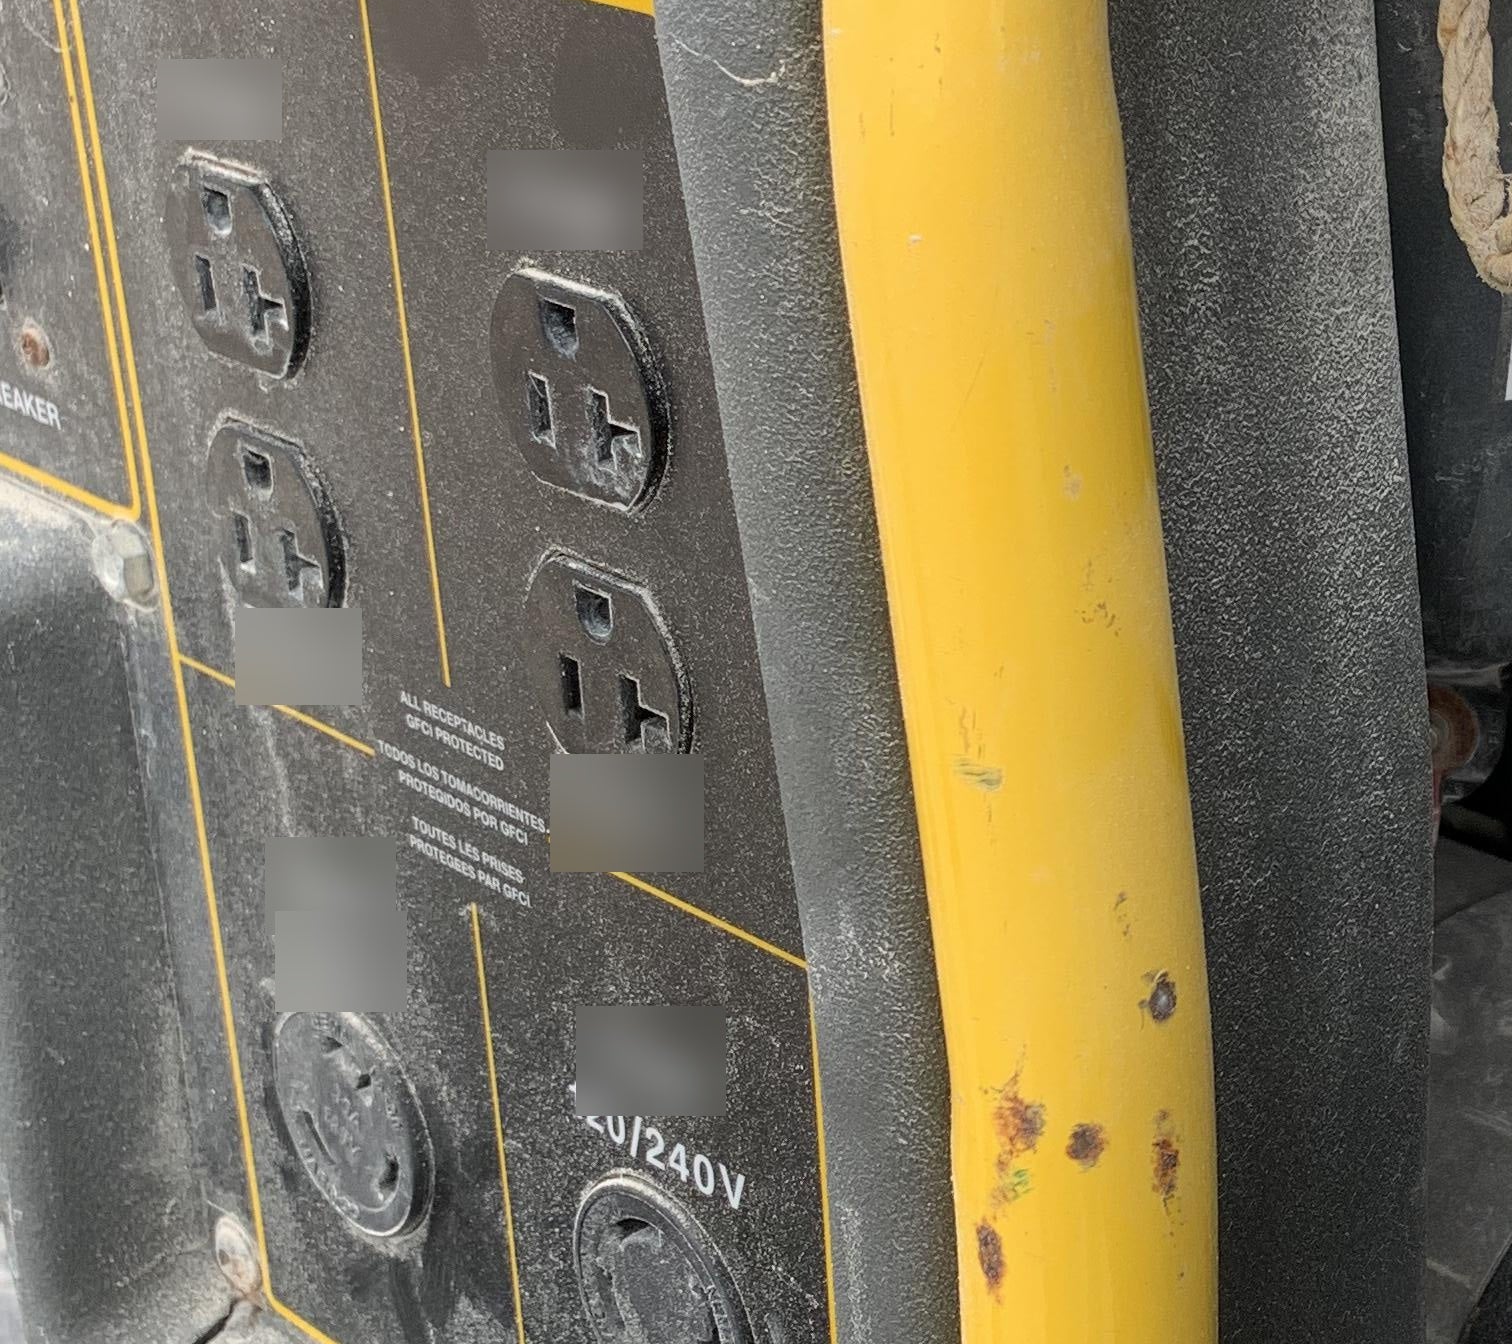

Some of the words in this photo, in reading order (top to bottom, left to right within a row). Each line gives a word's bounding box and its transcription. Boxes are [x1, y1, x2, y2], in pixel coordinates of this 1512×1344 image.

[0, 380, 62, 431] EAKER
[400, 690, 421, 712] ALL
[423, 700, 505, 751] RECEPTACLES
[406, 713, 433, 738] GFCI
[435, 727, 504, 771] PROTECTED
[378, 740, 416, 769] TODOS
[418, 759, 440, 781] LOS
[440, 770, 546, 834] TOMACORRIENTES
[399, 770, 472, 817] PROTEGIDOS
[473, 807, 498, 830] POR
[500, 821, 528, 846] GFCI
[409, 834, 476, 879] PROTEGEES
[477, 869, 501, 893] PAR
[503, 883, 532, 908] GFCI
[411, 816, 456, 850] TOUTES
[458, 839, 480, 862] LES
[482, 851, 524, 884] PRISES
